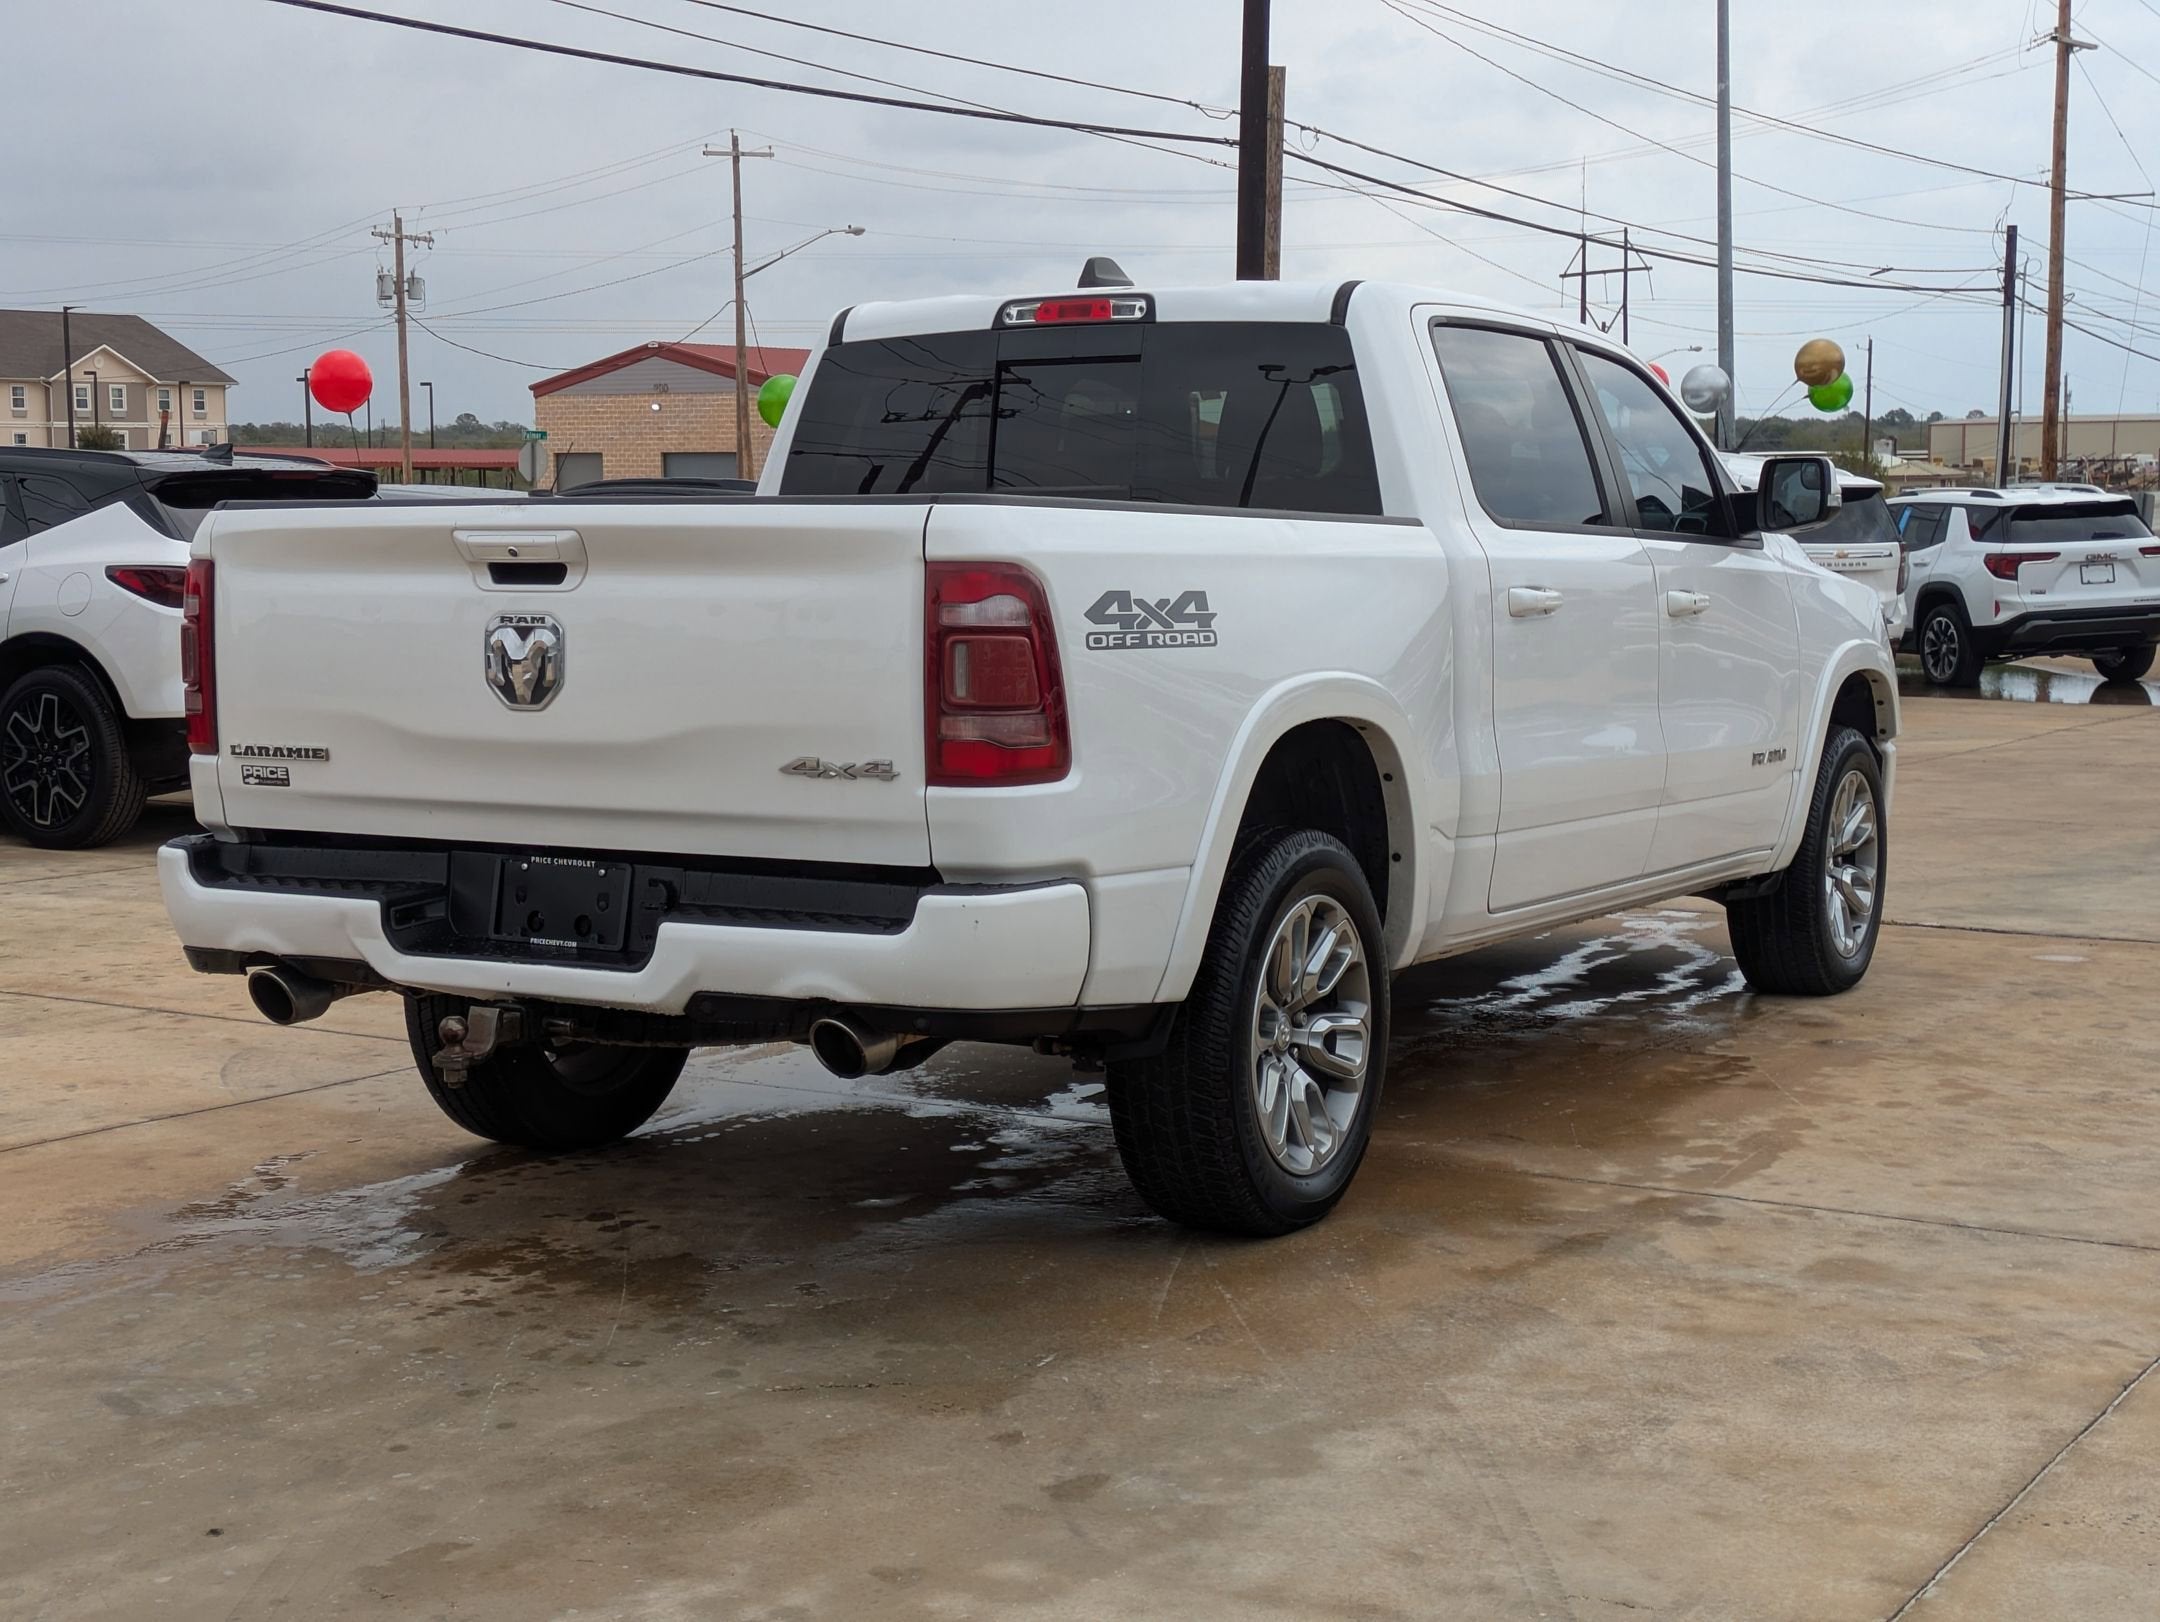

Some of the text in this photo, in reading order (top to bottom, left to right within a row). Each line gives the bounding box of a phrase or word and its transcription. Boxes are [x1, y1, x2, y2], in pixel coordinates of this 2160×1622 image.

[2086, 553, 2118, 561] GMC
[500, 615, 545, 624] RAM
[1088, 632, 1215, 648] OFF ROAD
[230, 744, 326, 760] LARAMIE
[242, 766, 288, 779] PRICE
[530, 856, 596, 868] PRICE CHEVROLET
[529, 937, 578, 948] PRICECHEVY.COM
